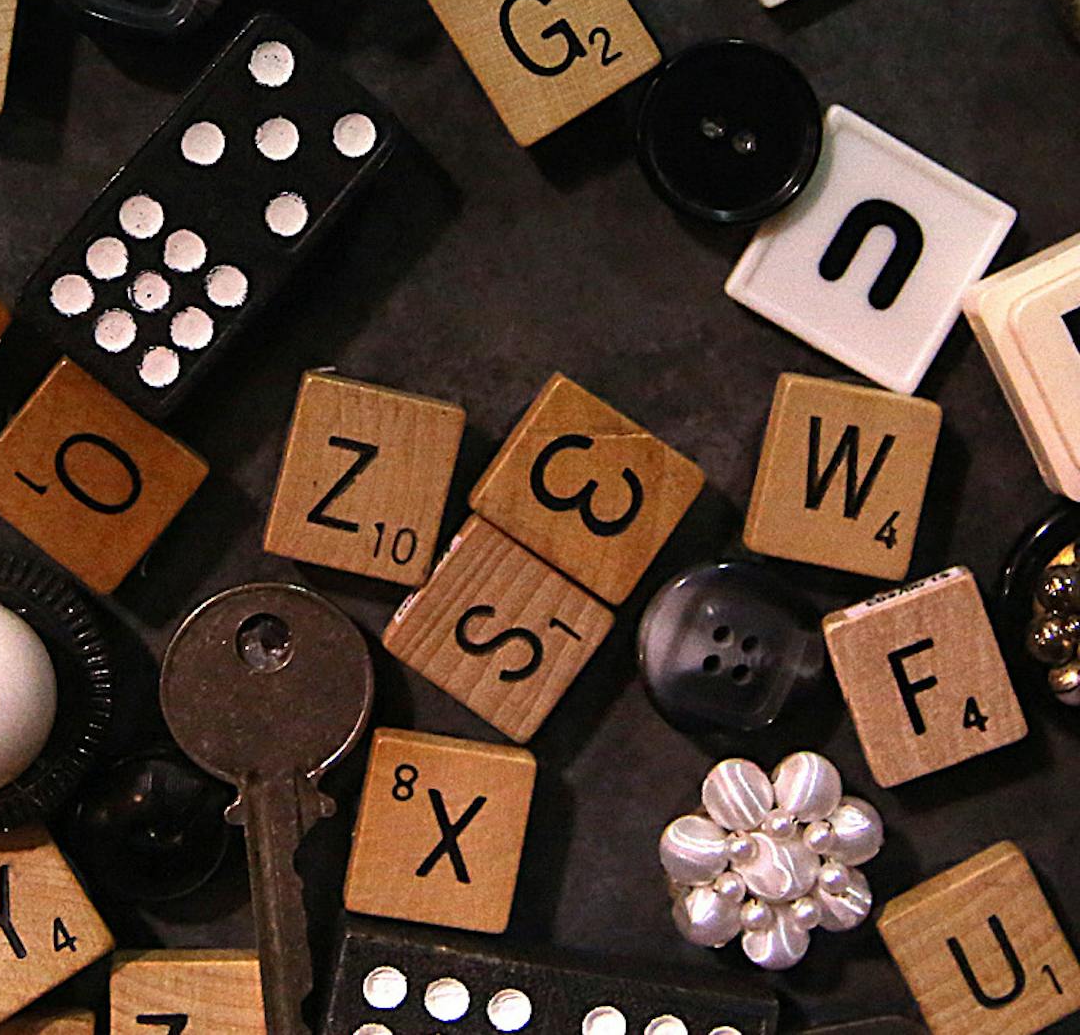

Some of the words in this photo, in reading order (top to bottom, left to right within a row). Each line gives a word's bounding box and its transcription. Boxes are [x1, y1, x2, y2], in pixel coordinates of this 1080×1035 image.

[55, 433, 142, 515] O
[307, 436, 379, 533] Z
[805, 416, 895, 520] W
[455, 605, 543, 683] S
[887, 638, 937, 735] F
[416, 789, 487, 884] X
[947, 915, 1025, 1009] U
